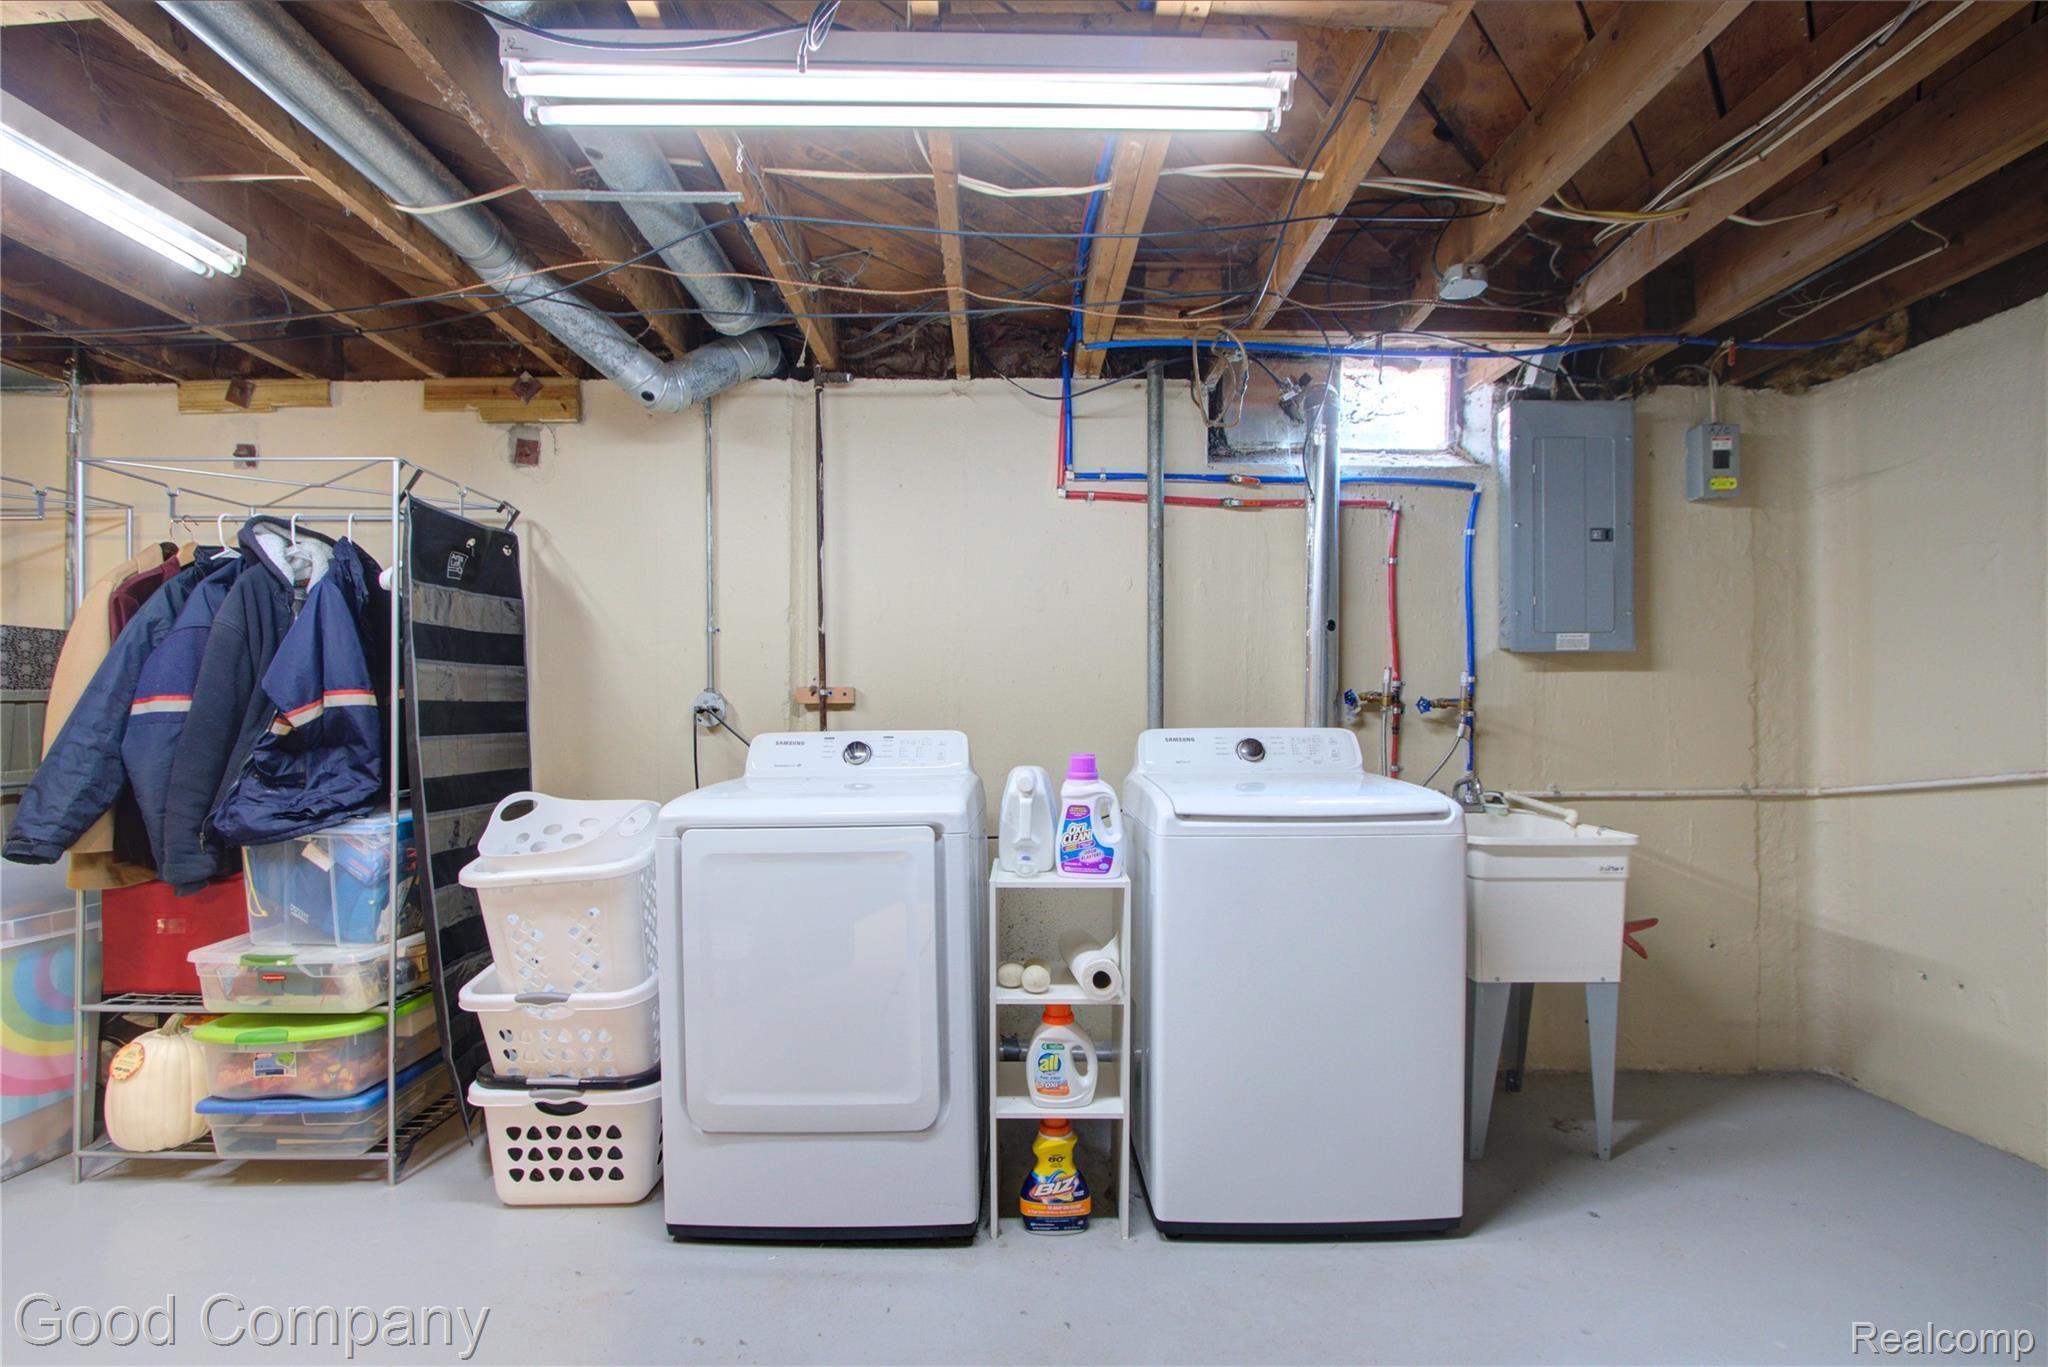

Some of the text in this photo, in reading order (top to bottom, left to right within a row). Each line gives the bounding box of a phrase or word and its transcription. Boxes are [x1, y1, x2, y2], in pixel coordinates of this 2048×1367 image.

[1069, 824, 1085, 835] OXI
[1064, 831, 1092, 844] CLEAN
[1039, 1054, 1059, 1072] all
